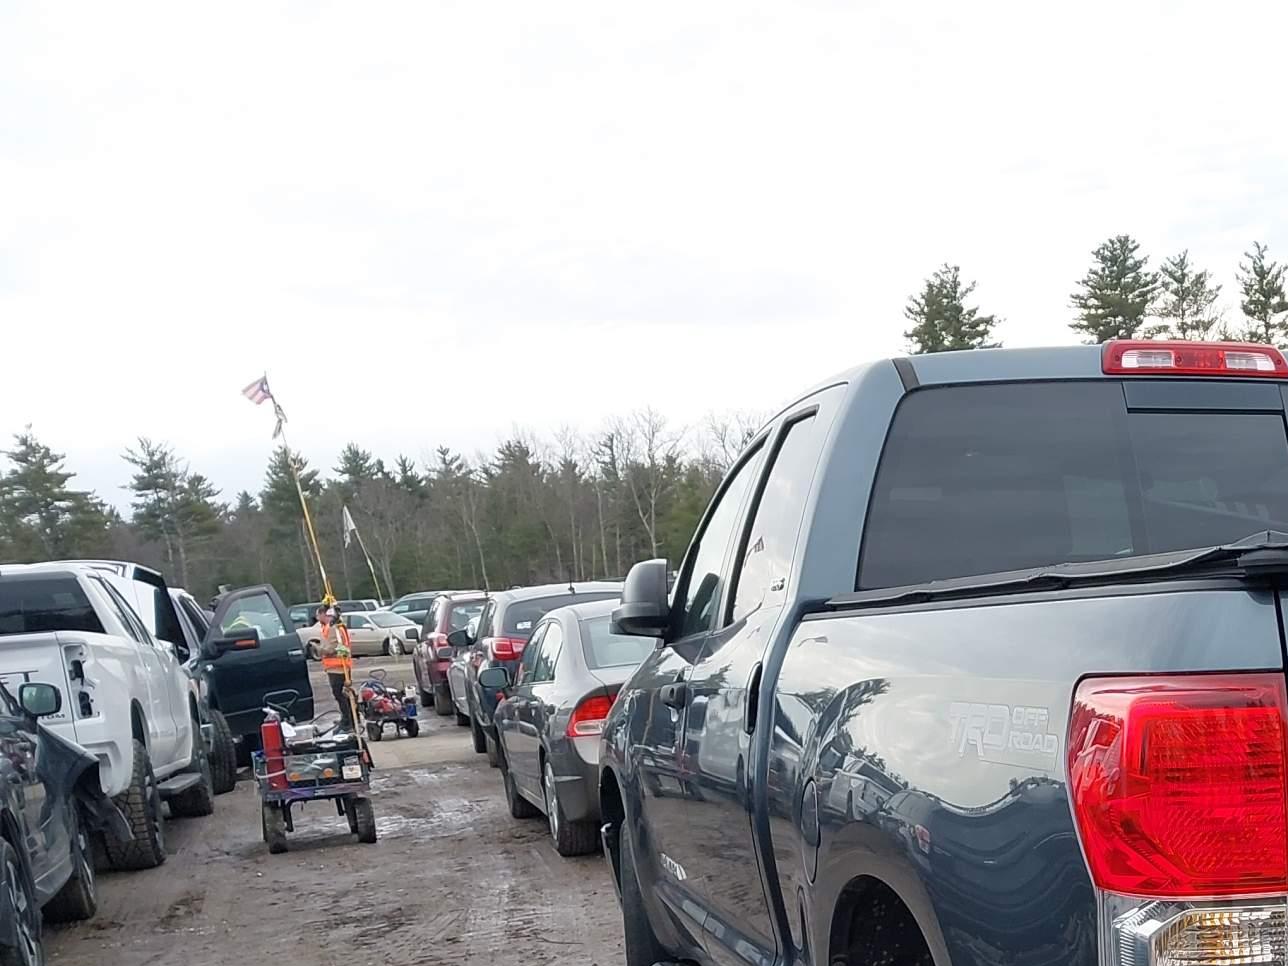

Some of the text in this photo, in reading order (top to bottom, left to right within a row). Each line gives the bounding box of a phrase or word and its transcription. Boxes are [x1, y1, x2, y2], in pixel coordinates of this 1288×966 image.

[1012, 706, 1048, 727] OFF
[950, 702, 1010, 757] TRD
[1008, 730, 1058, 754] ROAD
